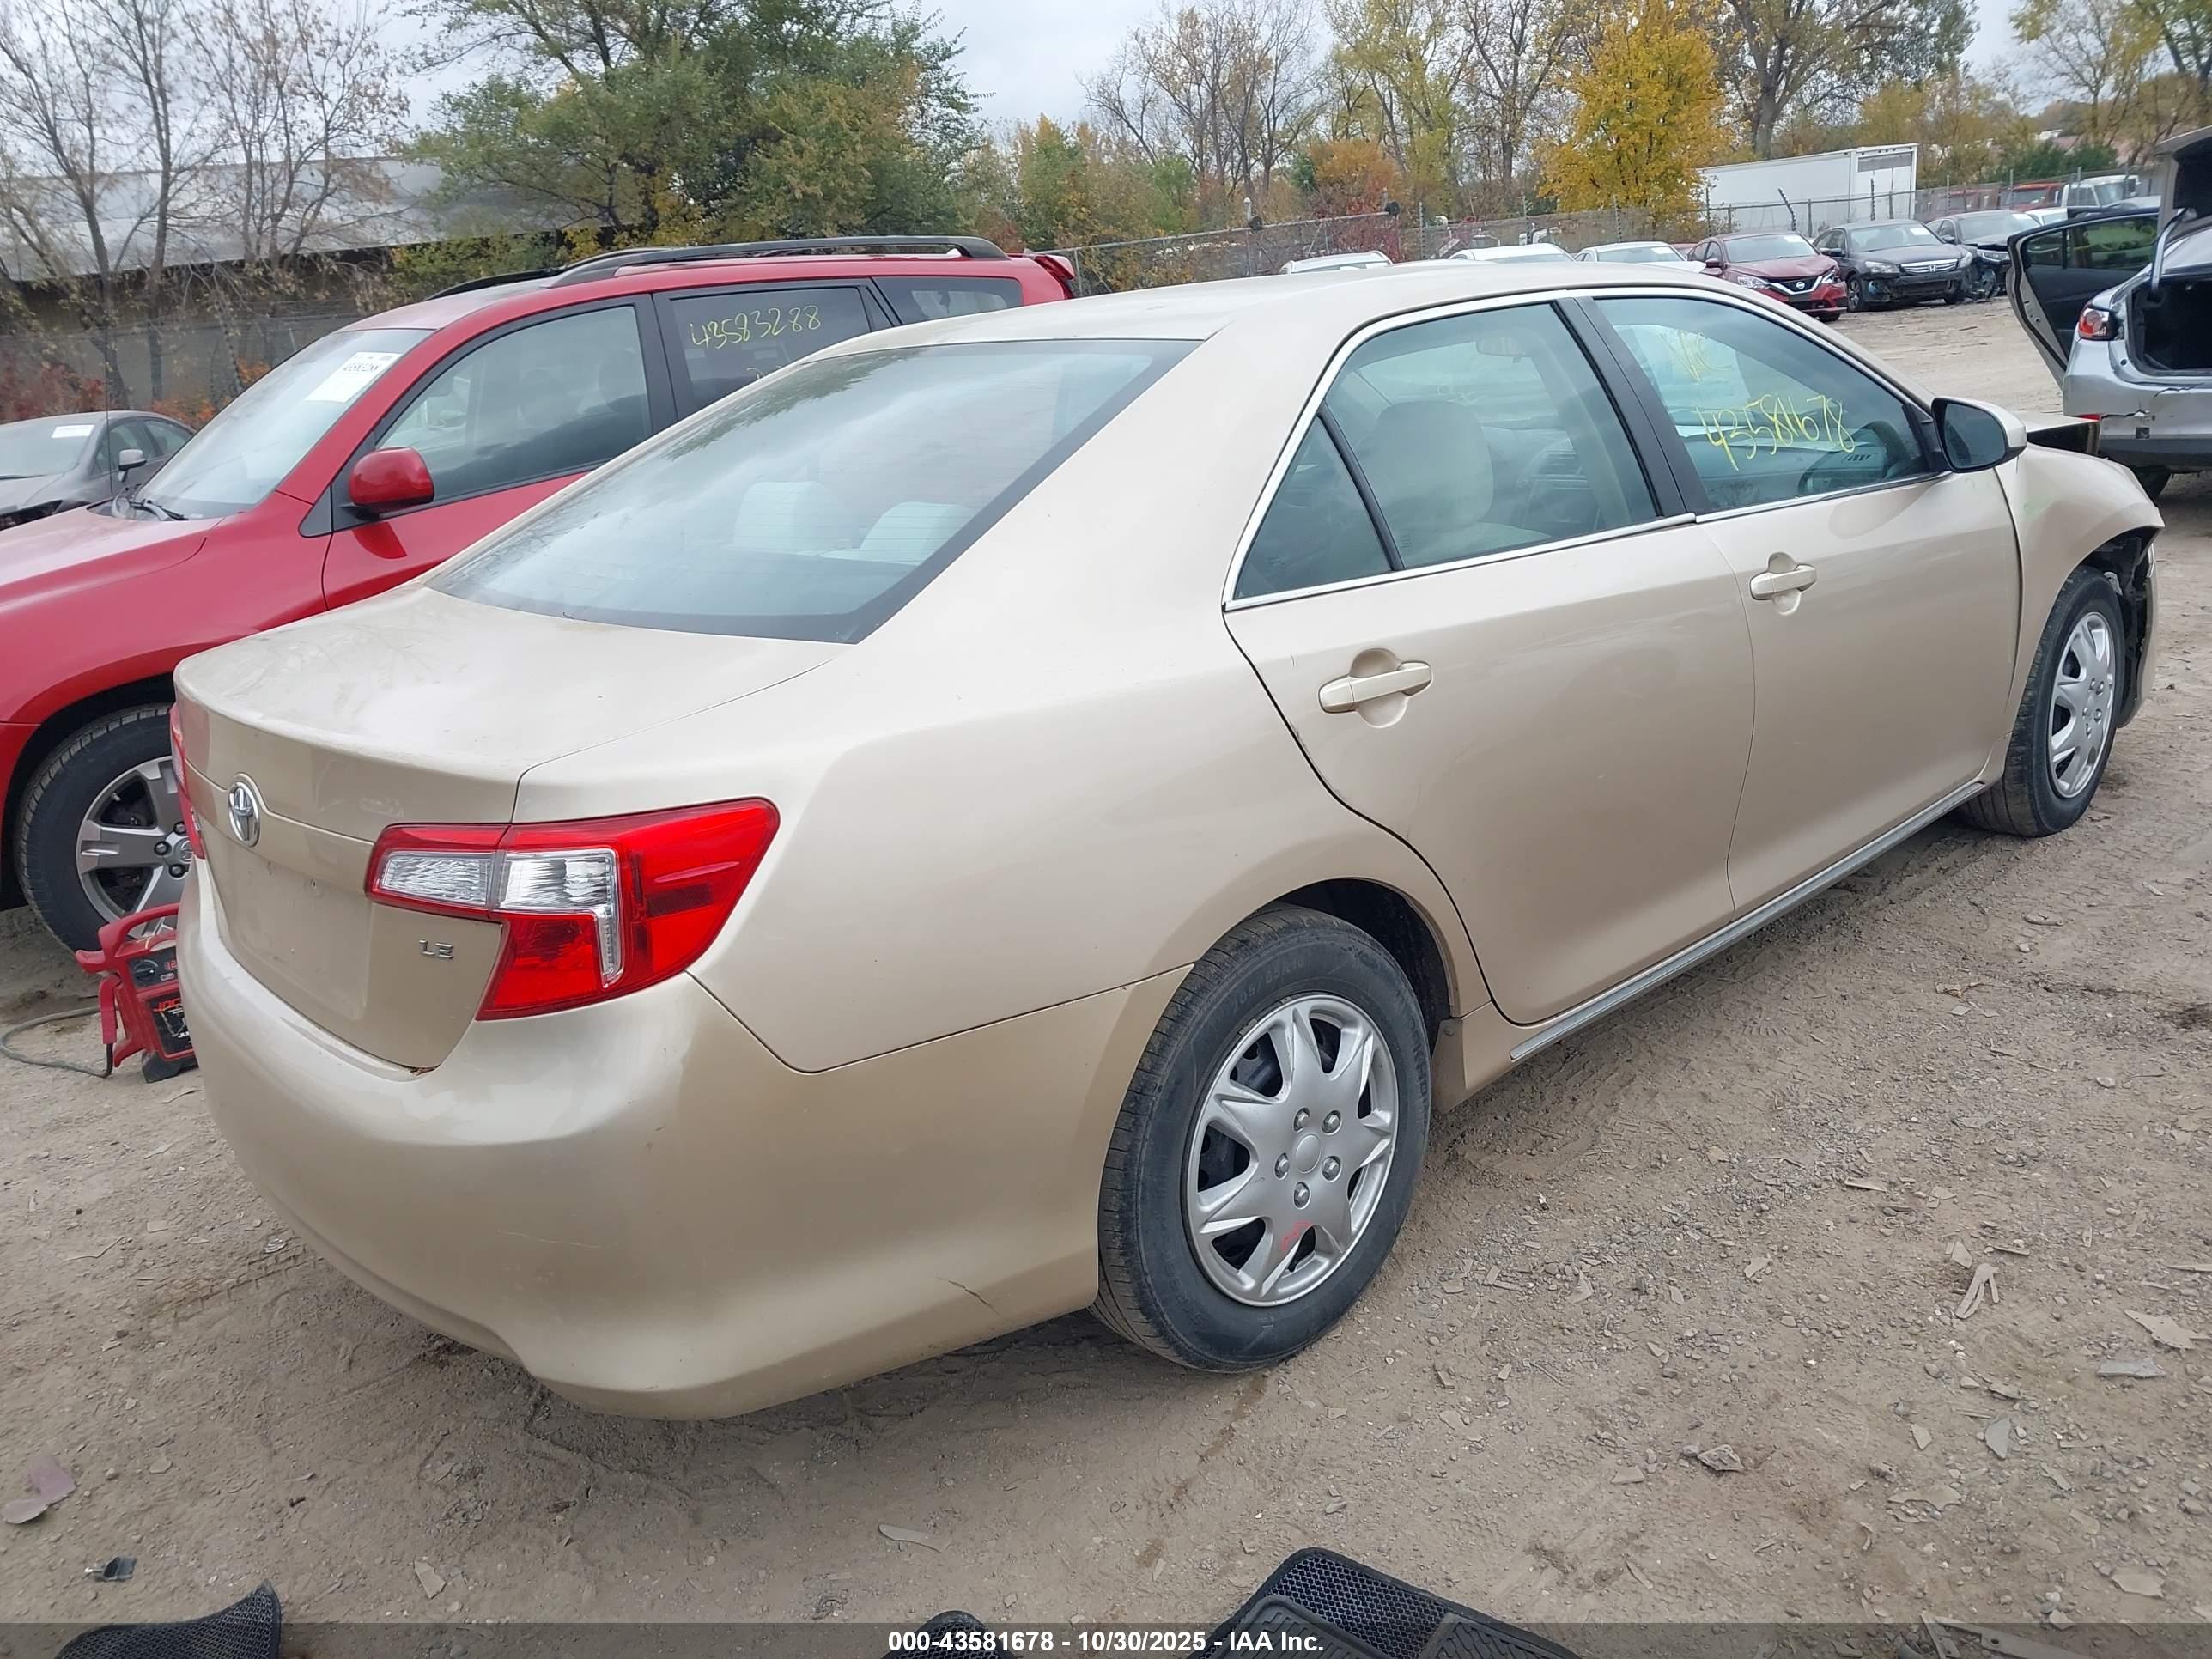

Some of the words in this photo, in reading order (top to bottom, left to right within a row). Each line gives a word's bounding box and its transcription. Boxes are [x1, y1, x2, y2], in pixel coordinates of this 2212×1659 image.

[690, 305, 822, 349] 43583288
[1695, 392, 1856, 471] 43581678
[418, 939, 454, 960] LE
